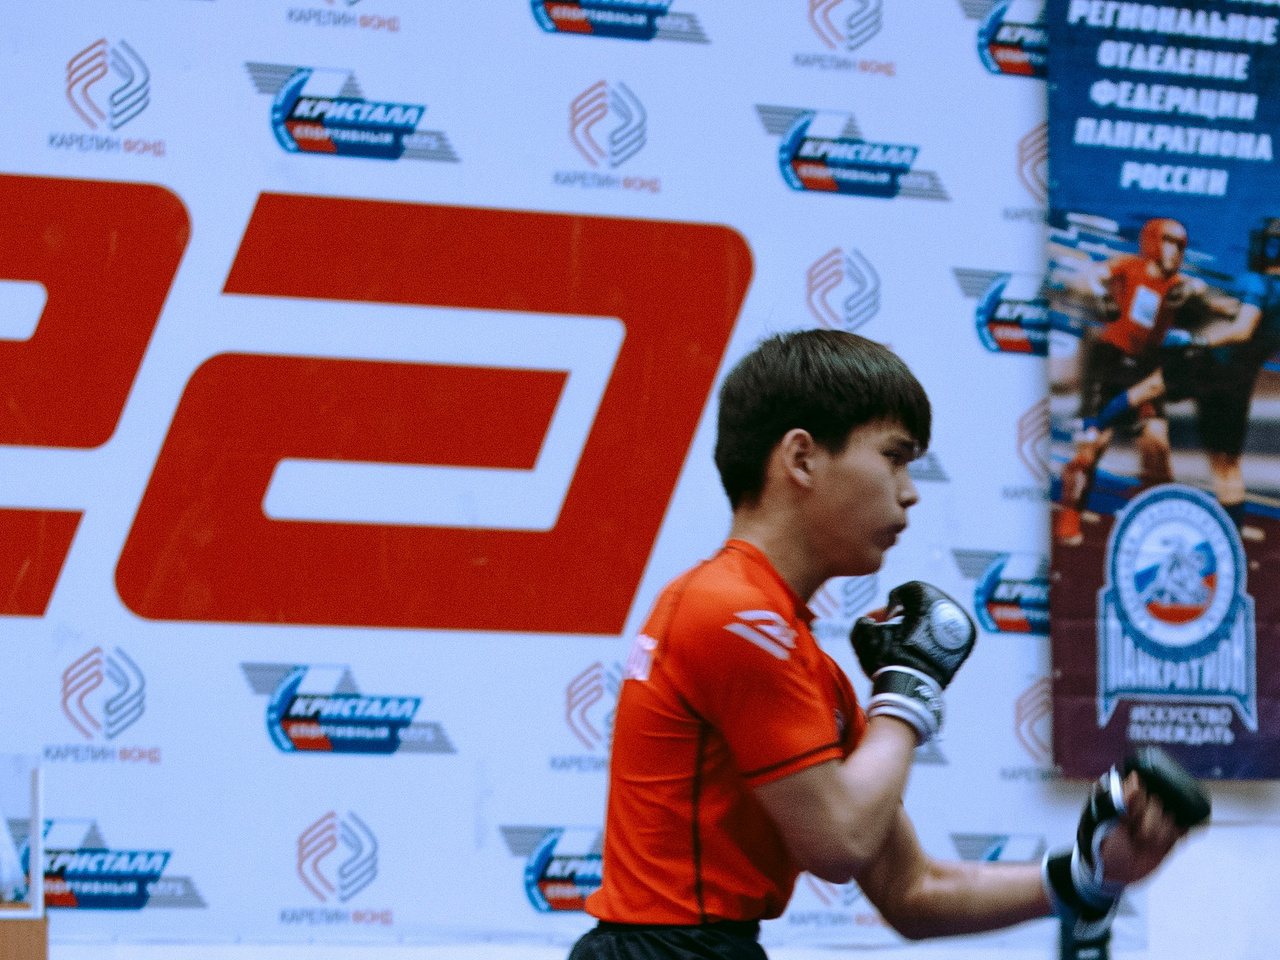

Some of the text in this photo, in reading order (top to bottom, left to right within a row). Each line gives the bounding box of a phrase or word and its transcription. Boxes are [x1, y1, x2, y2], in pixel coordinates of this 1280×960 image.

[1067, 0, 1280, 45] РЕГИОНАЛЬНОЕ
[1097, 40, 1250, 81] ОТДЕЛЕНИЕ
[292, 99, 425, 126] КРИСТАЛЛ
[1090, 79, 1258, 120] ФЕДЕРАЦИИ
[798, 138, 919, 165] КРИСТАЛЛ
[1073, 116, 1273, 162] ПАНКРАТИОНА
[1119, 161, 1229, 197] РОССИИ
[289, 695, 422, 720] КРИСТАЛЛ
